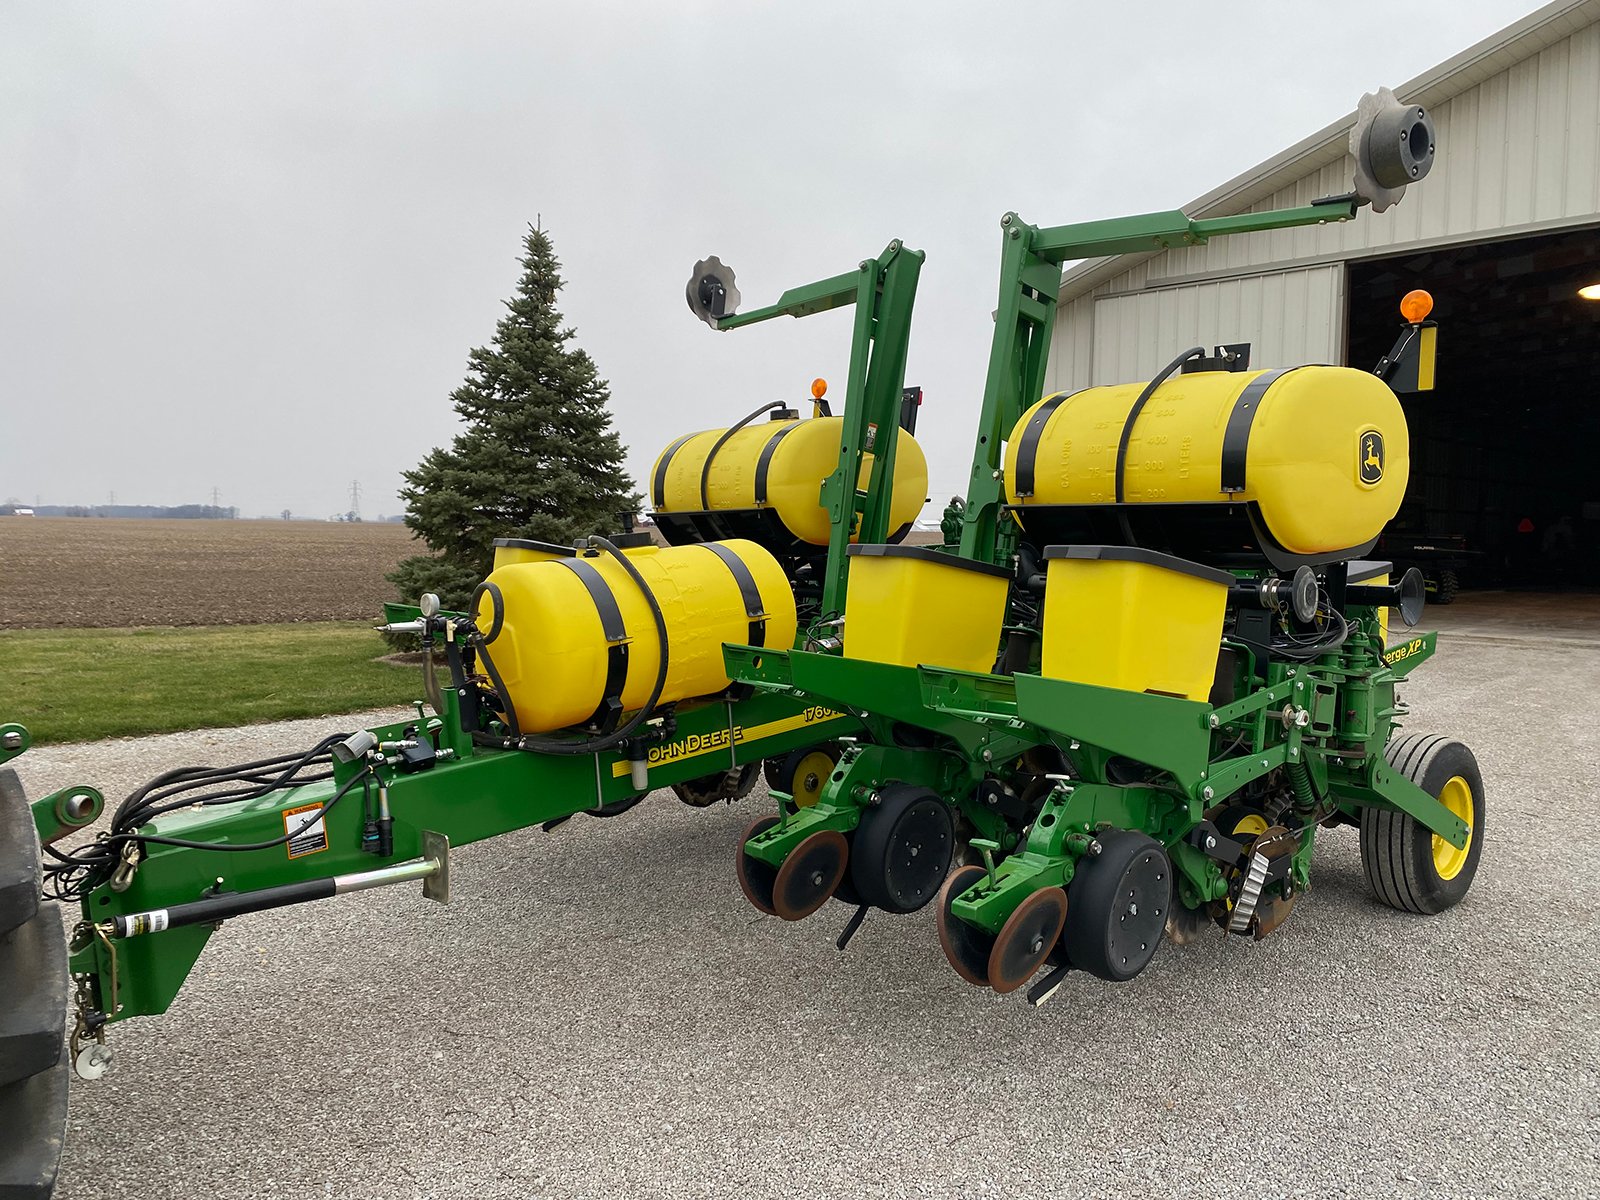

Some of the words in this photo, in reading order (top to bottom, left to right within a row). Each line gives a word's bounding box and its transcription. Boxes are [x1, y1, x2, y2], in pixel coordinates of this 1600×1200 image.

[1147, 434, 1168, 446] 400
[1061, 439, 1072, 488] GALLONS
[1144, 460, 1165, 472] 300
[1179, 434, 1192, 480] LITERS
[1147, 488, 1166, 498] 200
[1406, 639, 1422, 658] XP
[647, 740, 687, 763] OHN
[686, 725, 744, 752] DEERE
